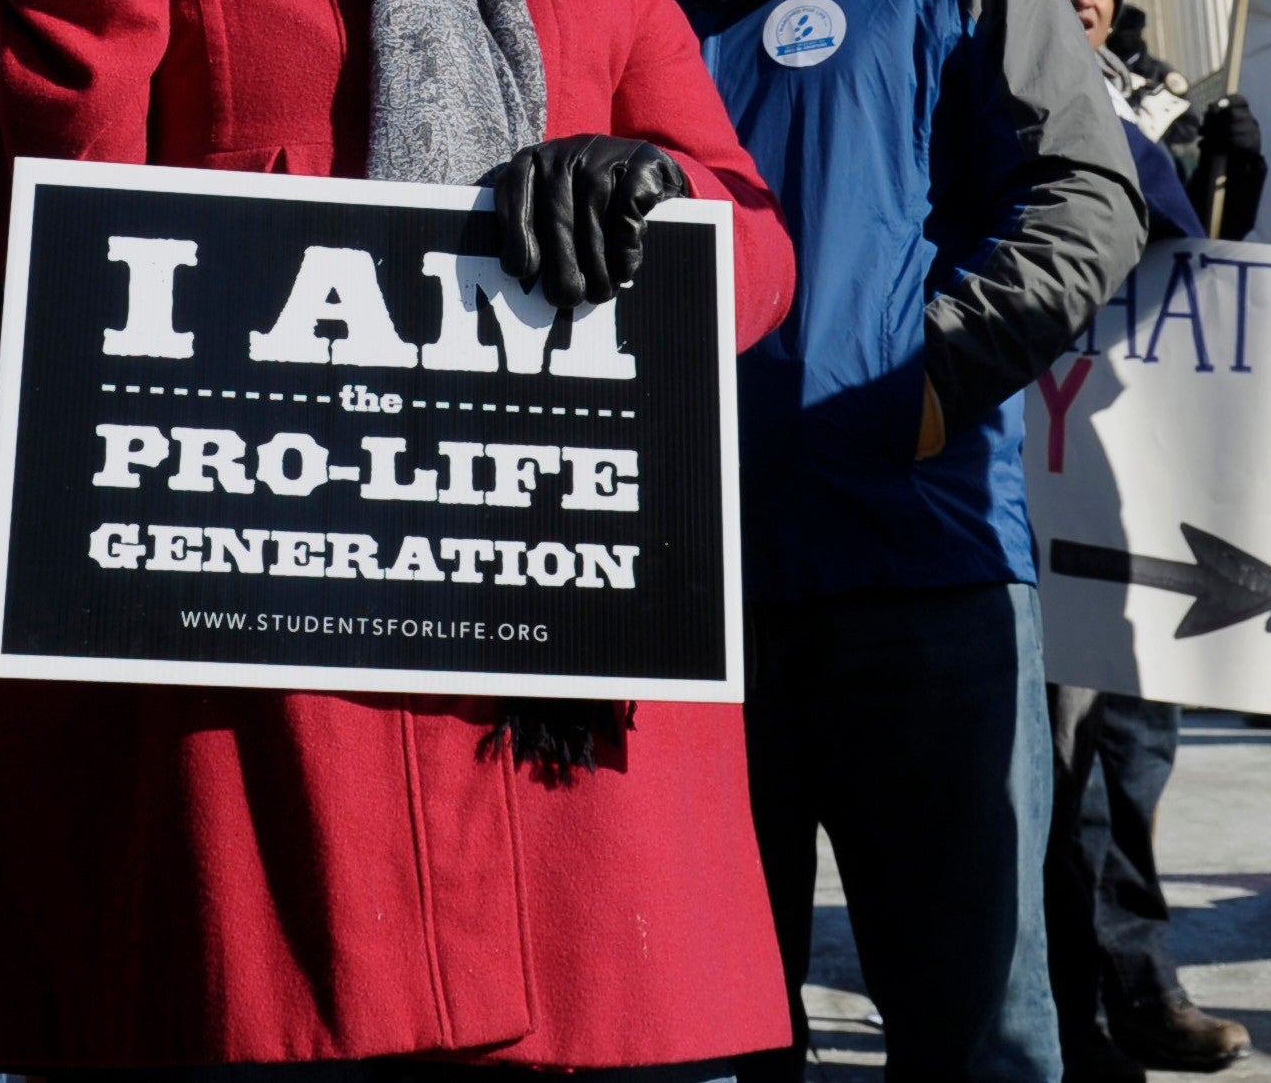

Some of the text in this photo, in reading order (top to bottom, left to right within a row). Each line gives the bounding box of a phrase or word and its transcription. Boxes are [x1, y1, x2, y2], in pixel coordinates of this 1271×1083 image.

[101, 235, 638, 380] I AM
[339, 384, 404, 414] the
[91, 423, 640, 513] PRO-LIFE
[88, 522, 640, 590] GENERATION
[180, 610, 549, 643] WWW.STUDENTSFORLIFE.ORG
